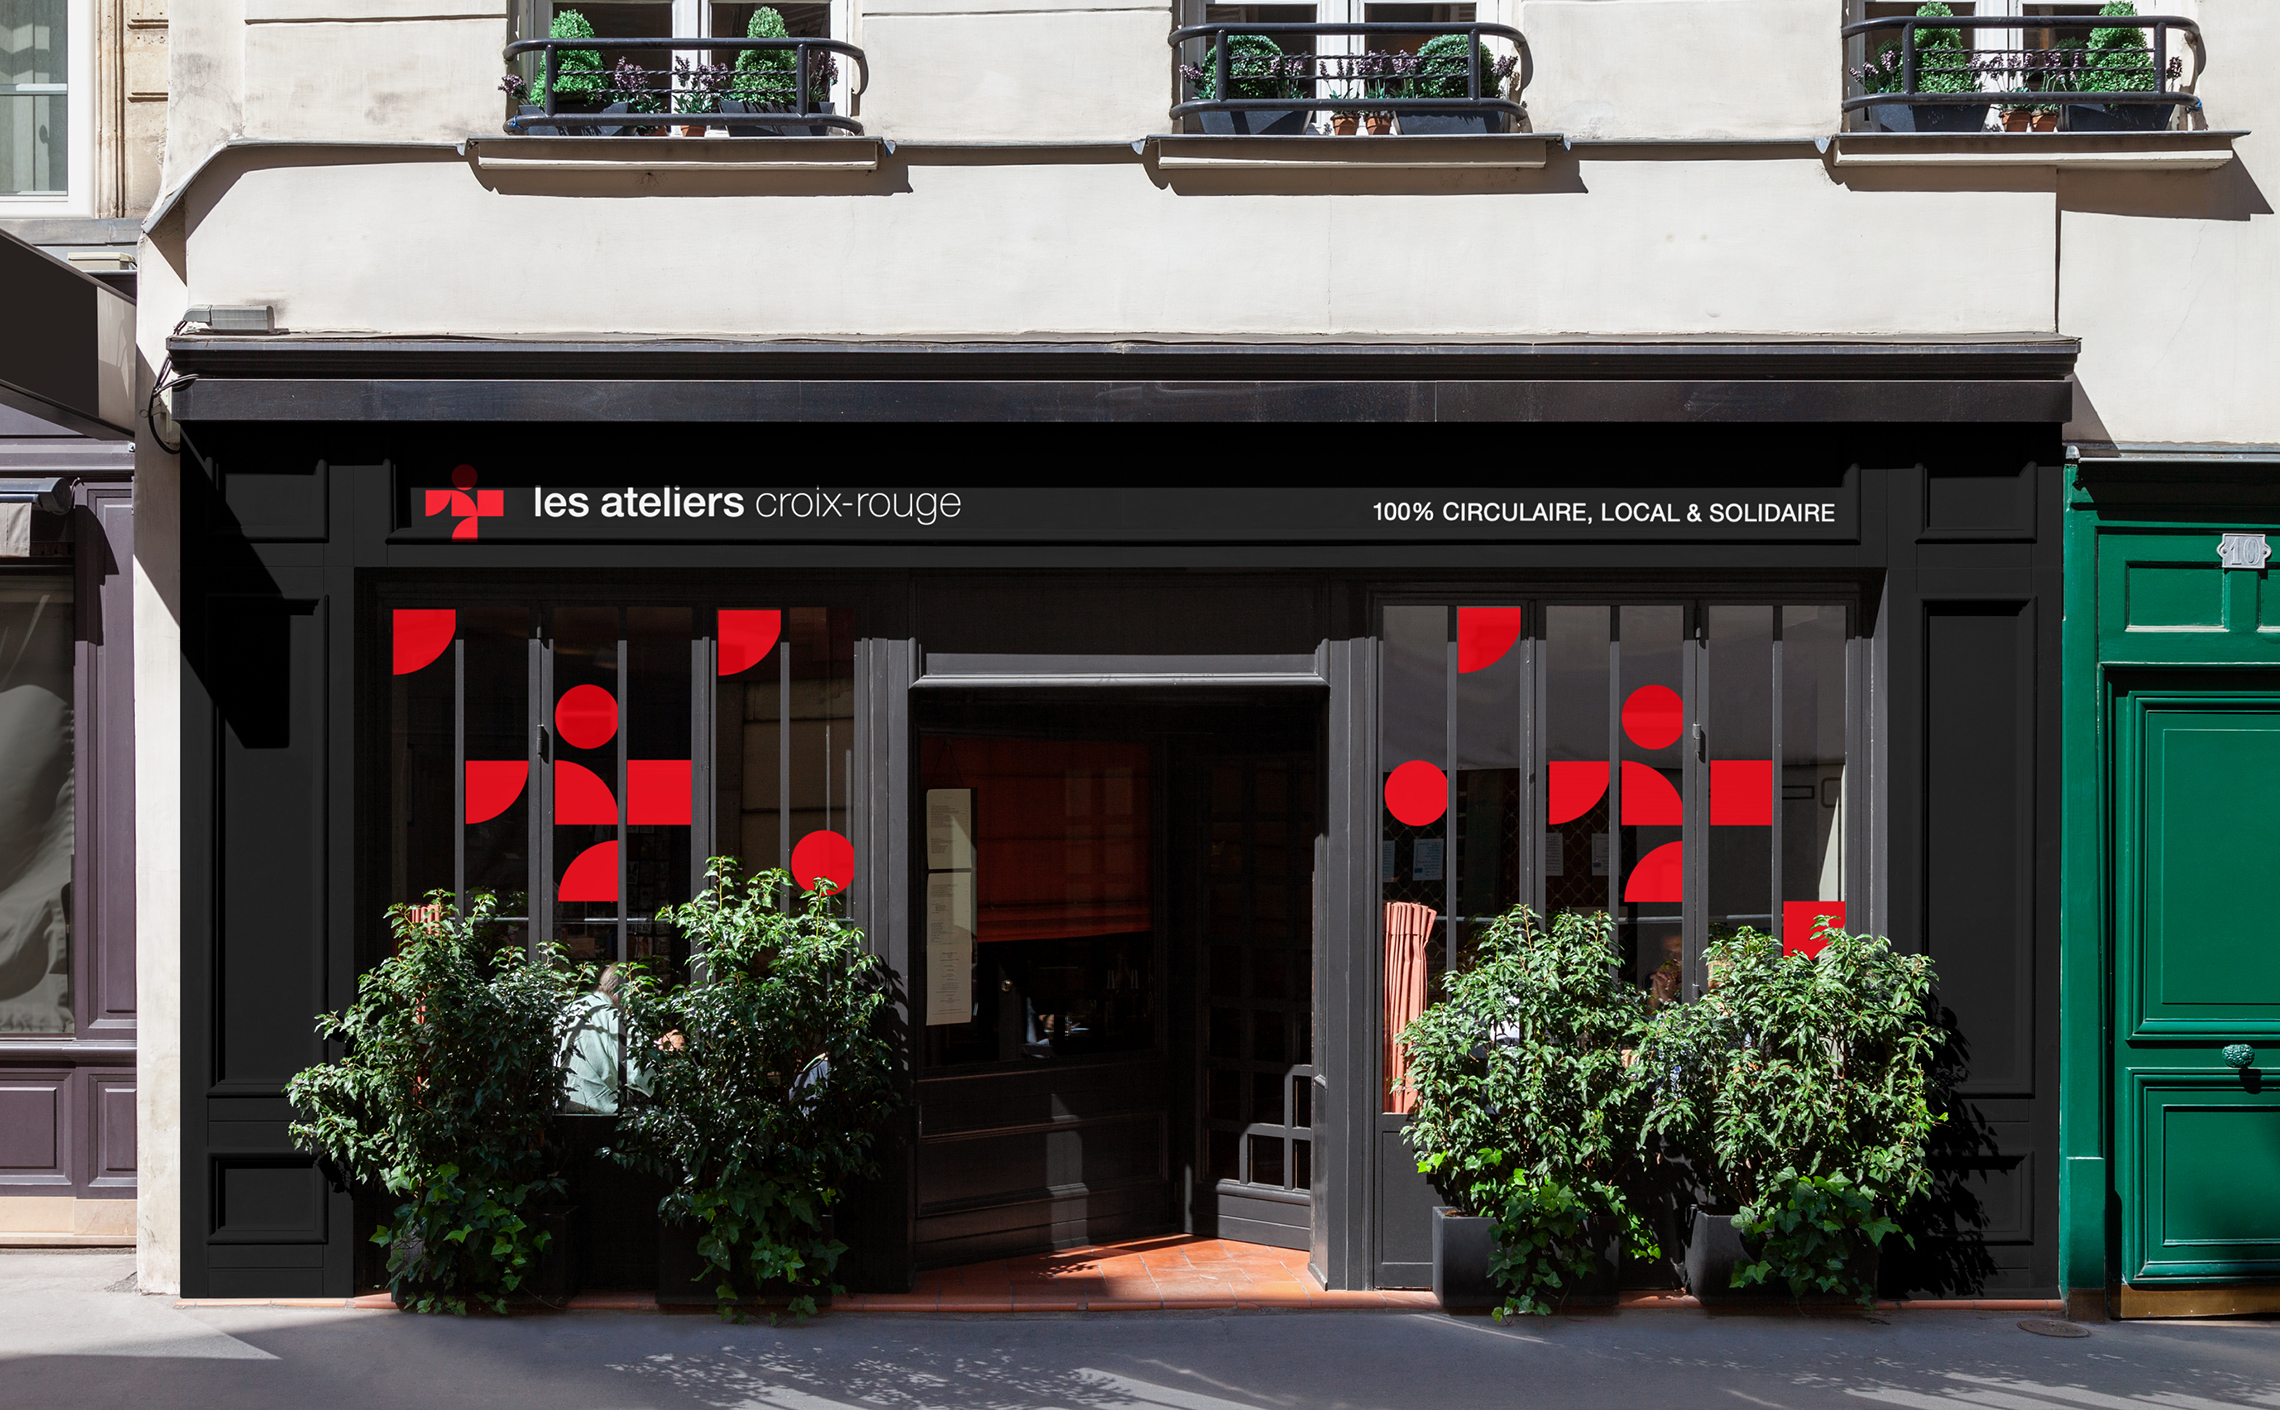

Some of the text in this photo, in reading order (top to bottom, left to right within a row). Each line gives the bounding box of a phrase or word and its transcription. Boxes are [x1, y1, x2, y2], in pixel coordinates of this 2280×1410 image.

[534, 486, 962, 526] les ateliers croix-rouge
[1373, 501, 1836, 526] 100% CIRCULAIRE, LOCAL & SOLIDAIRE
[2230, 537, 2261, 566] 10
